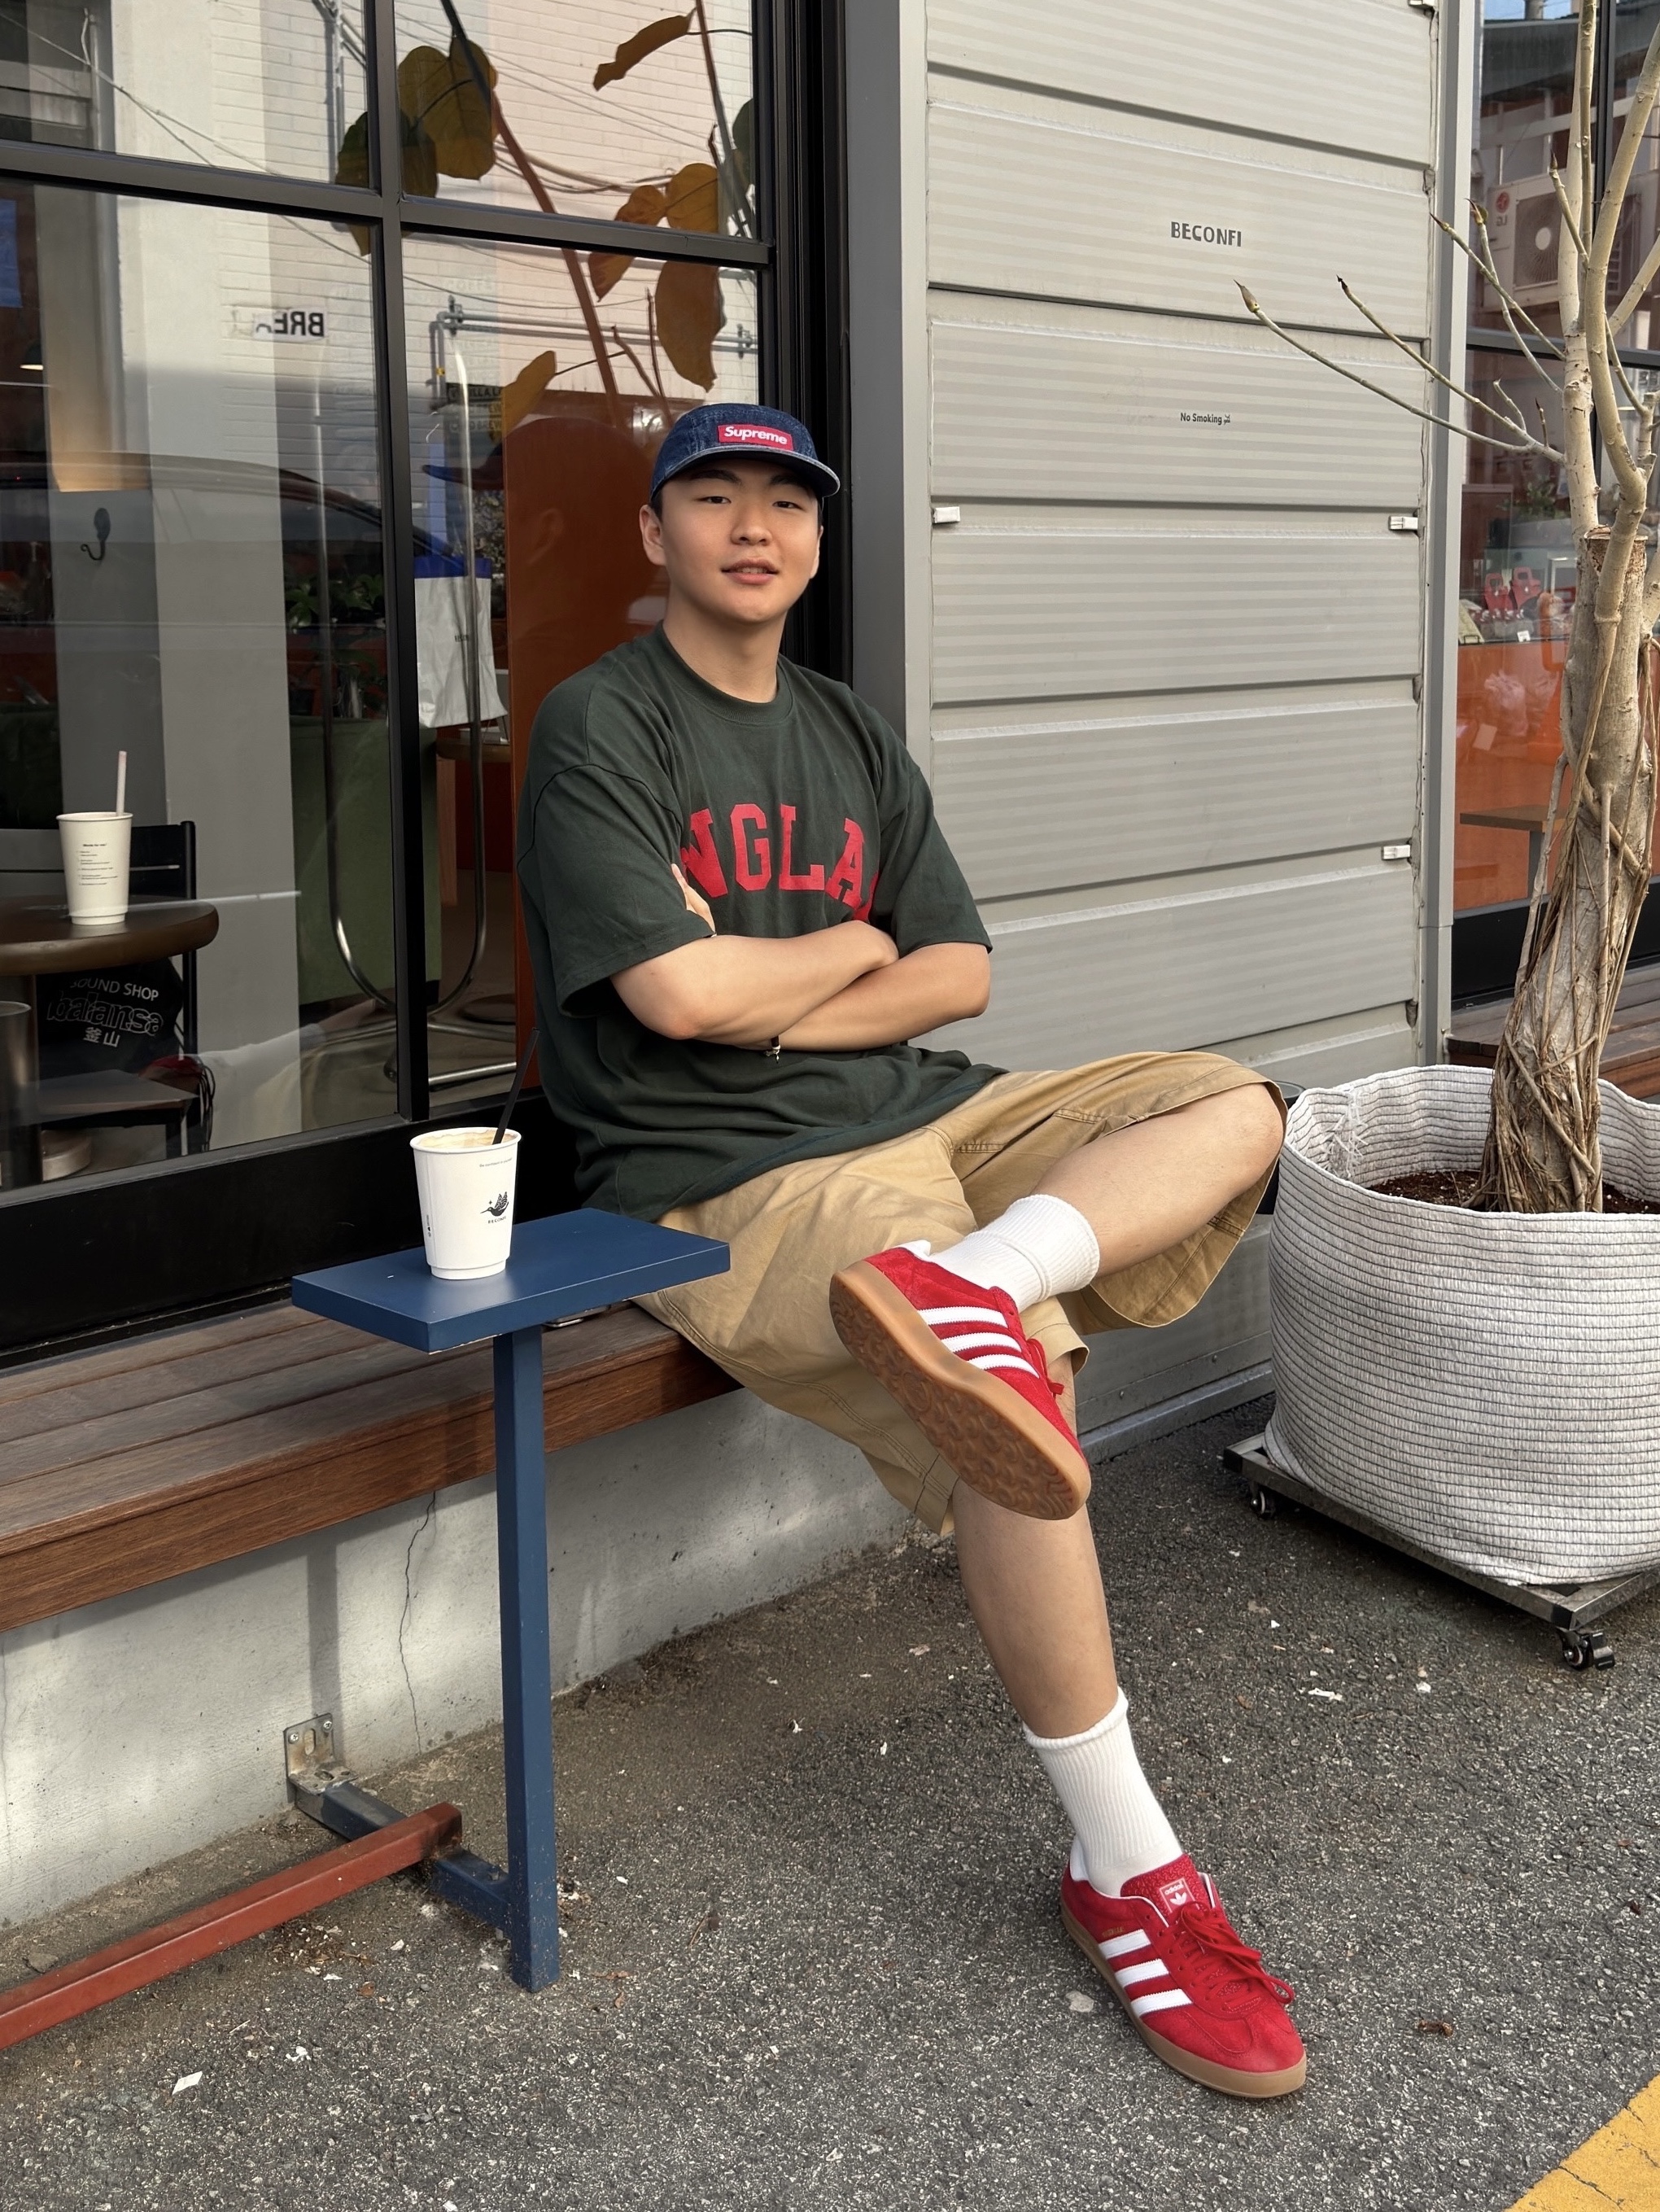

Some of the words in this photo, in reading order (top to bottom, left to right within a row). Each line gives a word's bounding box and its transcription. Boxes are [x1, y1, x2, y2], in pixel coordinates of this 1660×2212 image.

[1171, 221, 1241, 247] BECONFI
[1180, 412, 1190, 422] No
[1192, 413, 1222, 426] Smoking
[723, 426, 788, 445] Supreme
[123, 982, 159, 1002] SHOP
[46, 990, 164, 1037] balansa
[82, 1026, 120, 1047] 釜山
[1164, 1880, 1184, 1895] adidas
